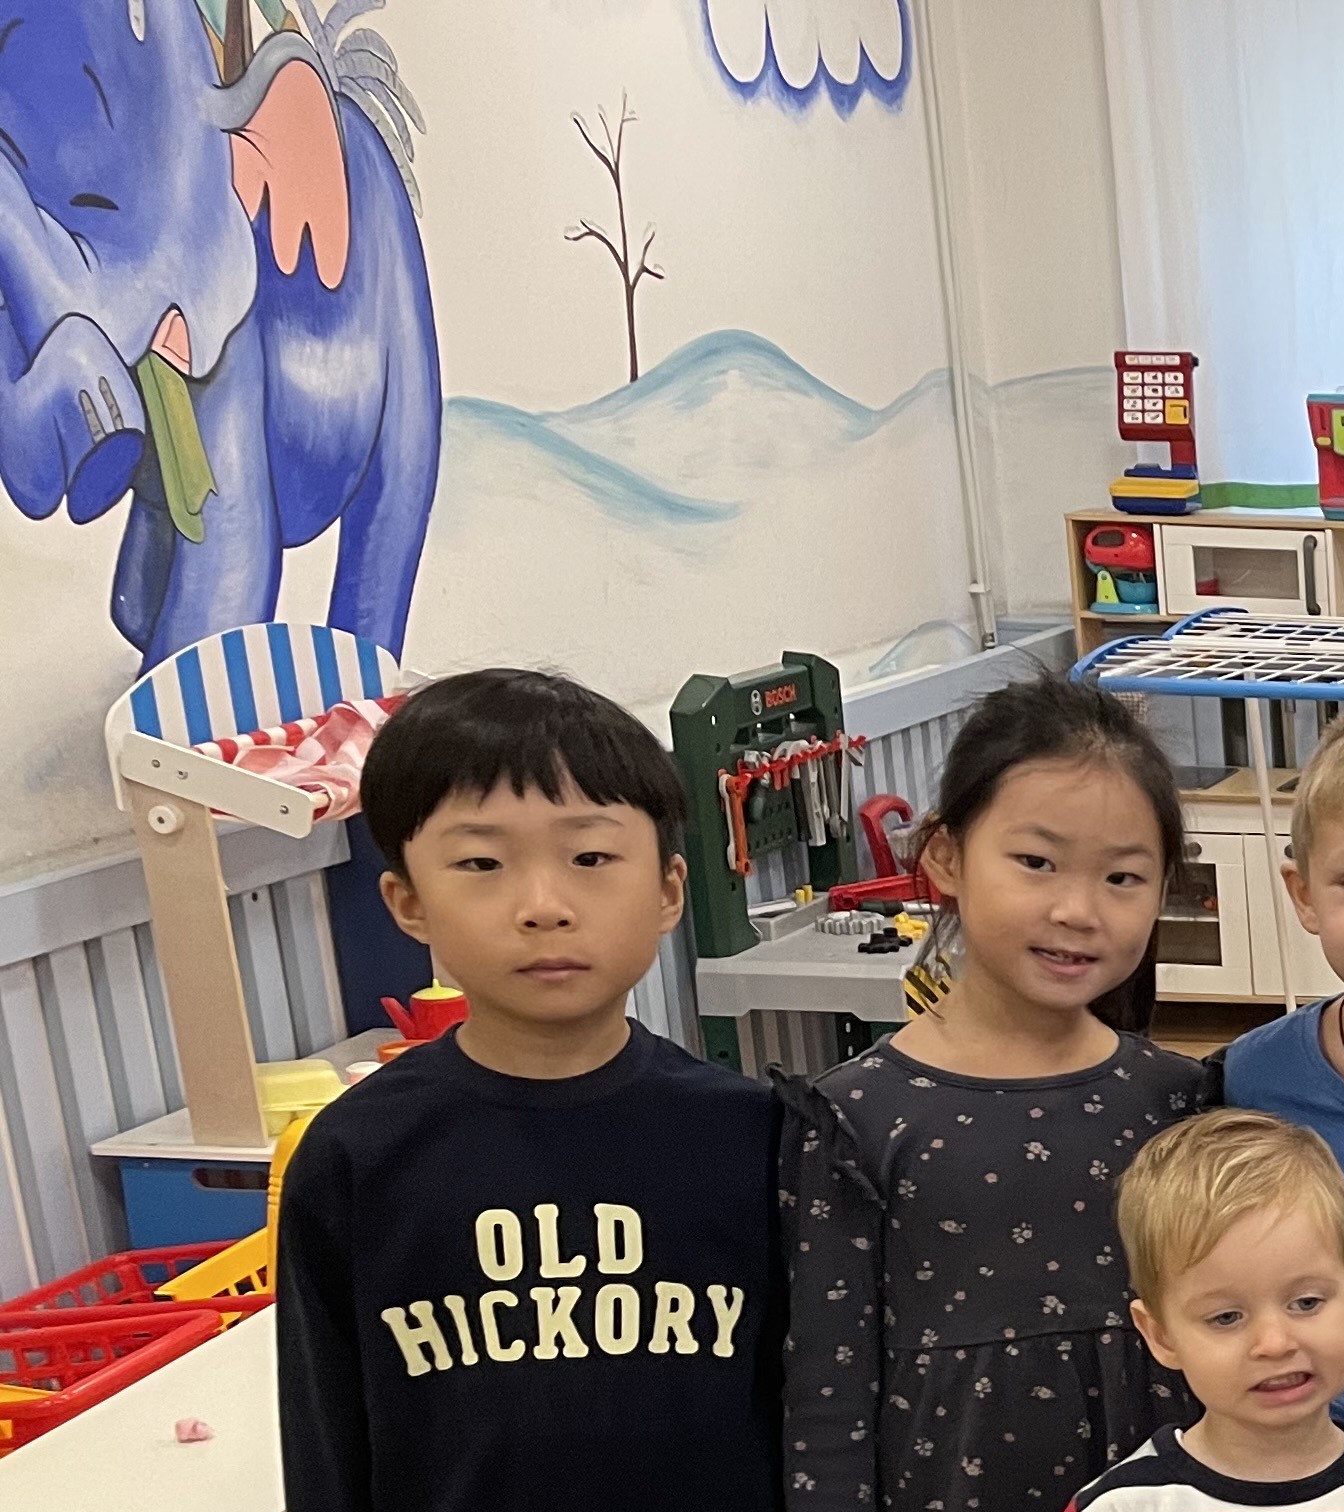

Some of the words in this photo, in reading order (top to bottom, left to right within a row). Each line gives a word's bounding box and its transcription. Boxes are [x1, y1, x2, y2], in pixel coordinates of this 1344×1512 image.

[764, 683, 798, 708] BOSCH
[474, 1202, 644, 1282] OLD
[380, 1280, 745, 1377] HICKORY
